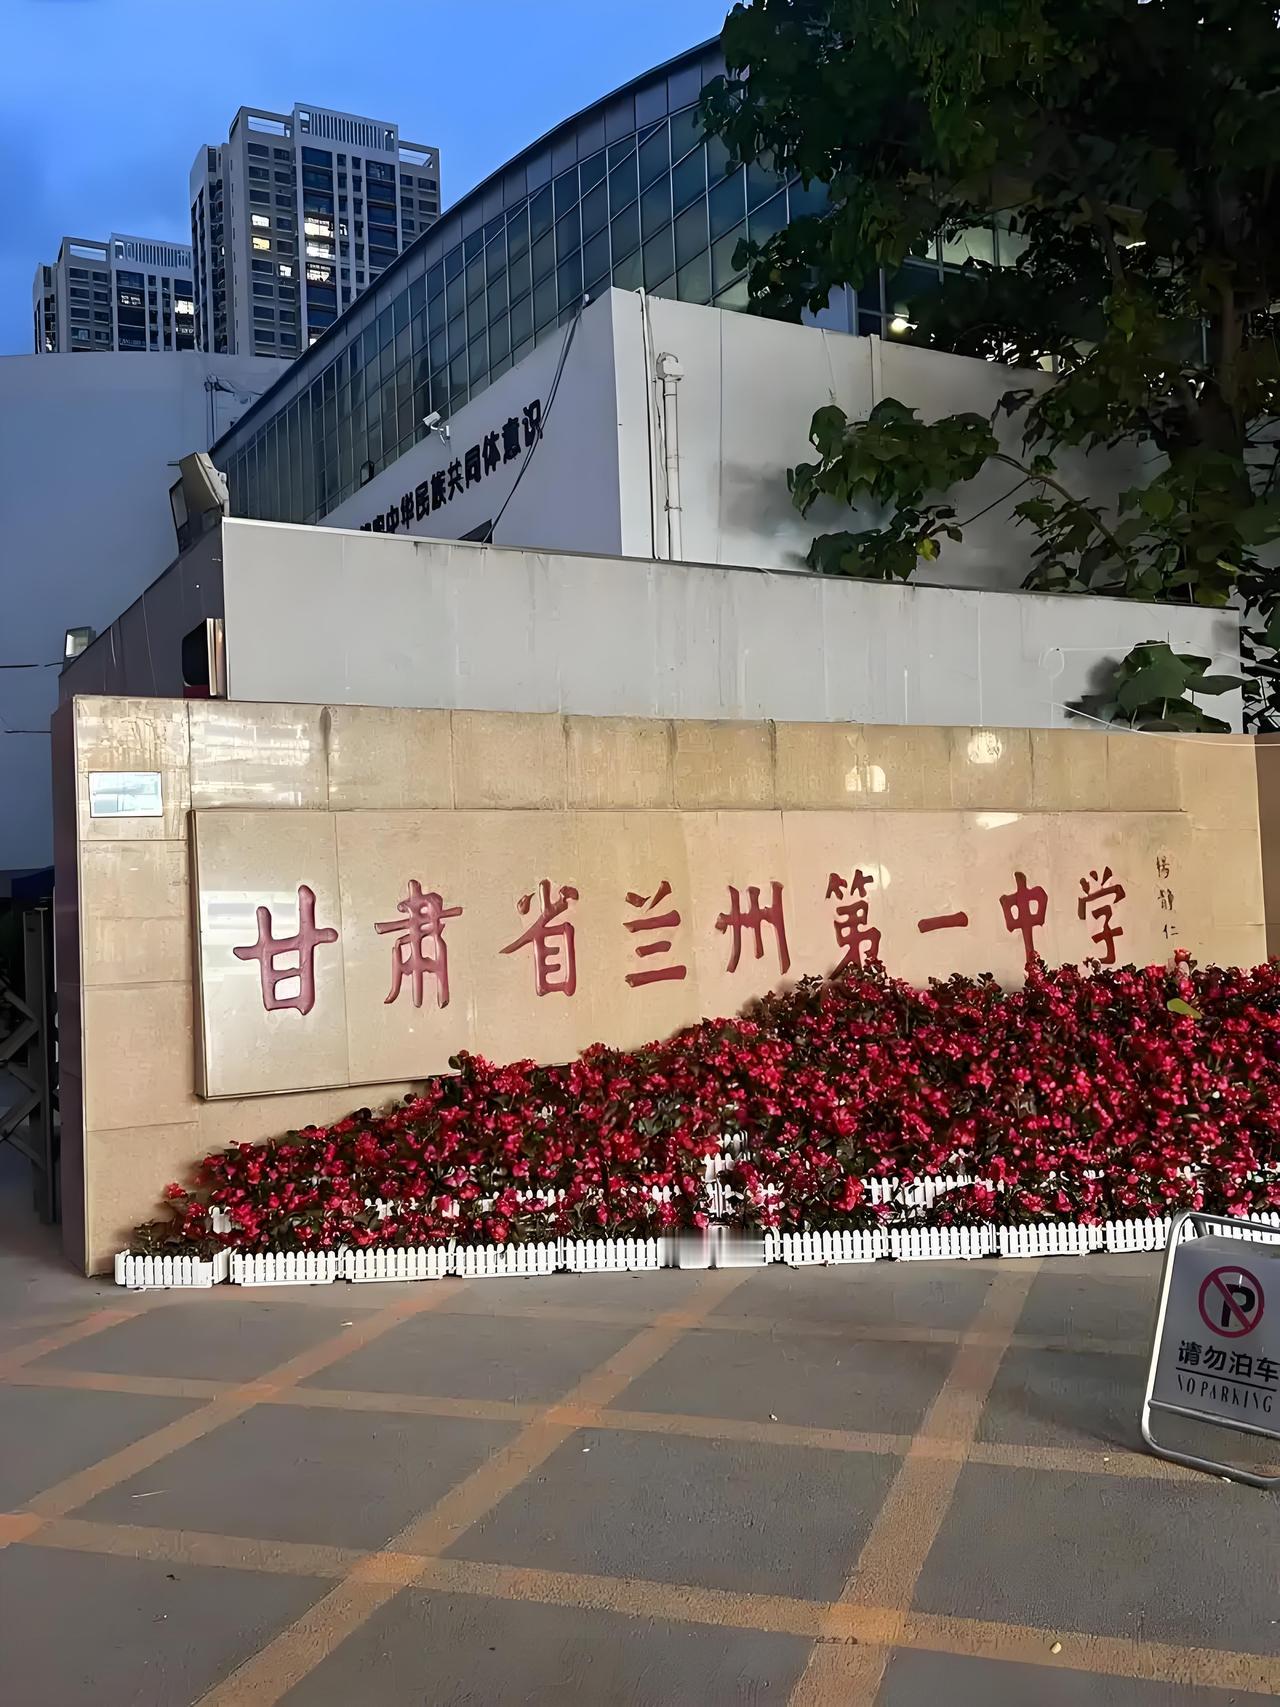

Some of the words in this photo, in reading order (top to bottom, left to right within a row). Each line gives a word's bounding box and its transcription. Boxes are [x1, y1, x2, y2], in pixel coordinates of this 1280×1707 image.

[360, 399, 543, 533] 中华民族共同体意识
[232, 866, 1127, 1016] 甘肃省兰州第一中学
[1178, 1340, 1280, 1382] 请勿泊车
